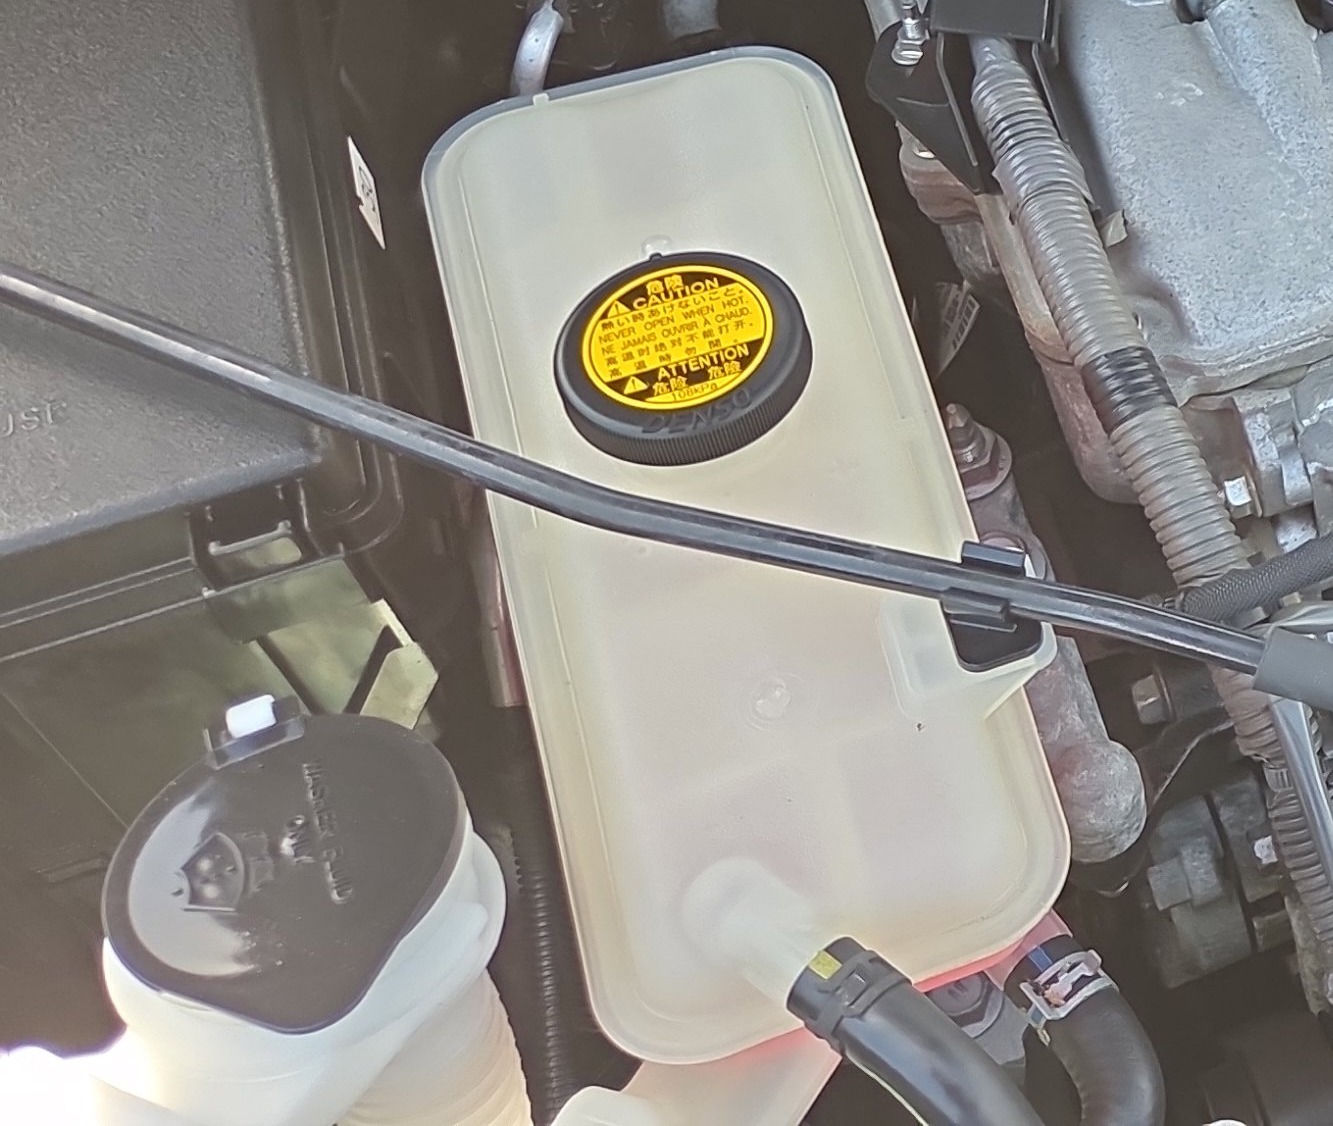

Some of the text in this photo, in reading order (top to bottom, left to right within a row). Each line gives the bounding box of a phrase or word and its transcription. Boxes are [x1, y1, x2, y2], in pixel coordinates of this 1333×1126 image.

[632, 277, 719, 310] CAUTION
[598, 295, 748, 344] NEVER OPEN WHEN HOT.
[600, 343, 615, 355] NE
[620, 331, 657, 350] JAMAIS
[661, 320, 699, 338] OUVRIR
[714, 306, 752, 323] CHAUD.
[656, 343, 749, 380] ATTENTION
[642, 390, 751, 435] DENSO
[671, 382, 718, 403] 108kPa
